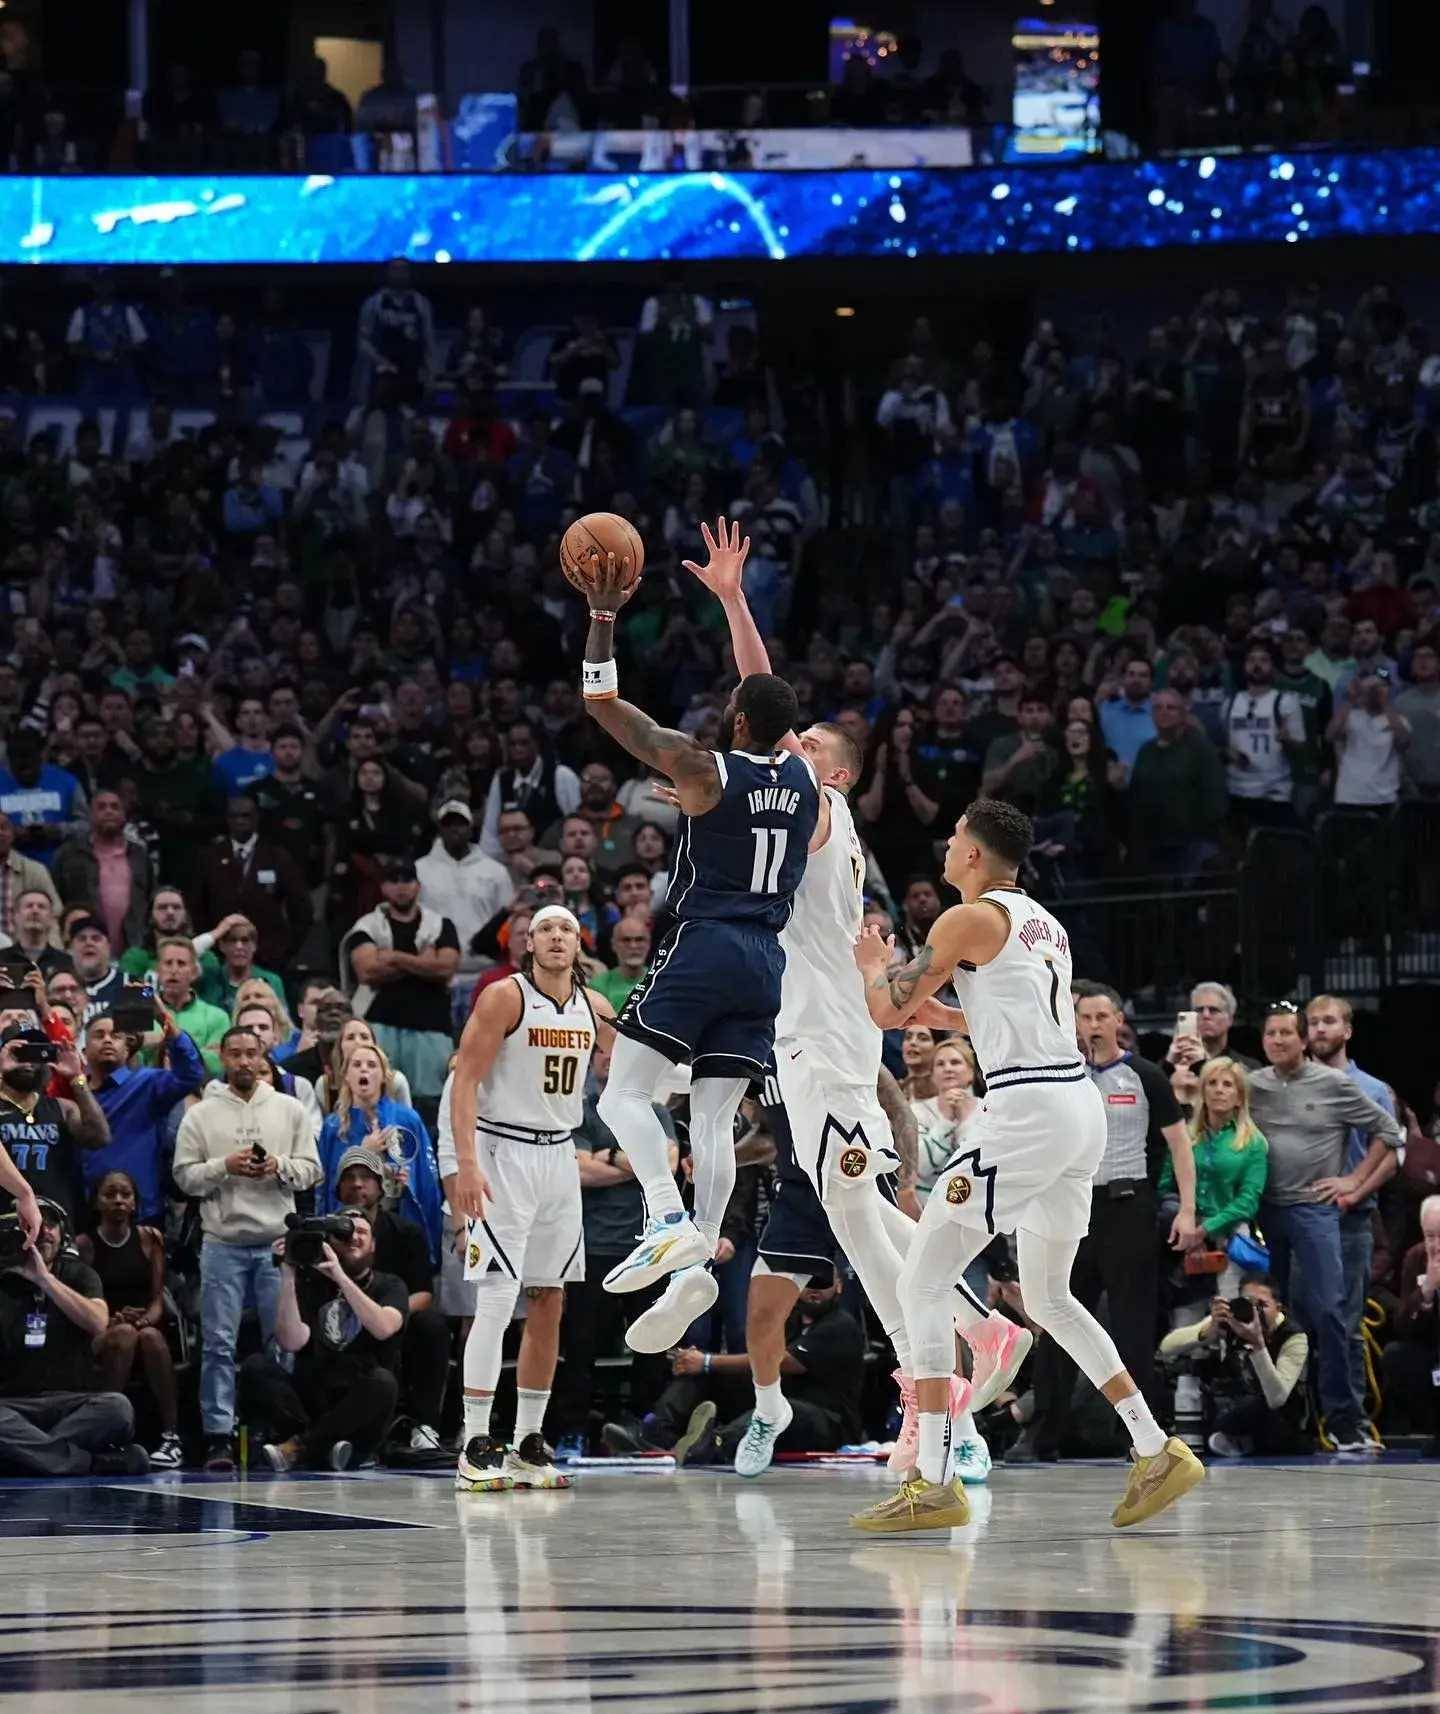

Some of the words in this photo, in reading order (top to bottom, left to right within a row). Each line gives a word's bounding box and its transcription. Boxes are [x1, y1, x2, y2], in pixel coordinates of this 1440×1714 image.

[748, 788, 800, 815] IRVING
[750, 828, 788, 894] 11
[1019, 918, 1052, 951] PORTER
[1045, 959, 1061, 1026] 1
[528, 1028, 591, 1050] NUGGETS
[544, 1055, 579, 1095] 50
[1, 1123, 60, 1146] MAVS
[12, 1144, 49, 1171] 77
